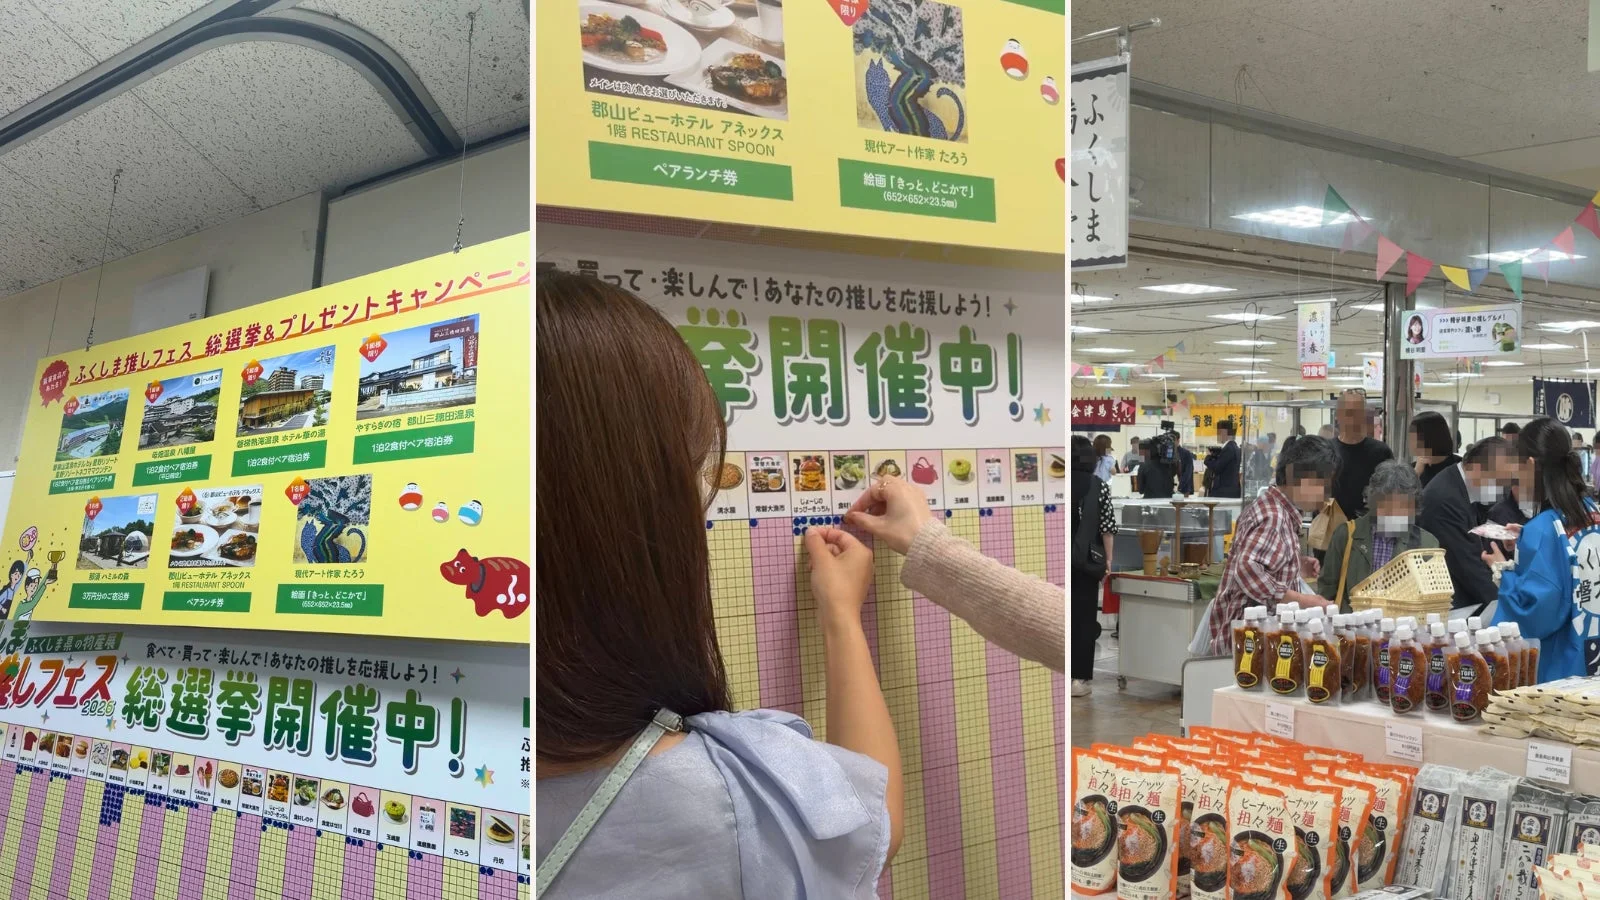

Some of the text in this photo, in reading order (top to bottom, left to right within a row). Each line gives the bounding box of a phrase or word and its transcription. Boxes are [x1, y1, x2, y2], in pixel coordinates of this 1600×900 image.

[591, 100, 785, 141] 郡山ビューホテル アネックス
[606, 124, 776, 157] 1階 RESTAURANT SPOON
[864, 138, 969, 167] 現代アート作家 たろう
[653, 162, 739, 187] ペアランチ券
[1084, 94, 1104, 242] ふくしま
[863, 172, 976, 198] 絵画「きっと、どこかで」
[75, 342, 192, 383] ふくしま推しフェス
[356, 409, 475, 432] やすらぎの宿 郡山三穂田温泉
[372, 435, 453, 453] 1泊2食付ペア宿泊券
[247, 452, 310, 467] 1泊2食付ペア宿泊券
[755, 505, 786, 513] 常磐大漁市
[168, 571, 251, 581] 郡山ビューホテル アネックス
[295, 569, 365, 579] 現代アート作家 たろう
[181, 581, 220, 589] RESTAURANT
[222, 581, 245, 589] SPOON
[82, 591, 129, 601] 3万円分のご宿泊券
[187, 598, 224, 607] ペアランチ券
[27, 634, 117, 652] ふくしま県の物産展
[81, 700, 115, 716] 2026
[122, 665, 464, 774] 総選挙開催中!
[1198, 793, 1224, 811] 担々
[1154, 811, 1164, 822] 生
[1237, 809, 1283, 834] 担々麺
[1291, 810, 1316, 828] 々麺
[1376, 817, 1387, 829] 生
[1274, 840, 1285, 851] 生
[1307, 832, 1318, 845] 生
[453, 848, 470, 857] たろう
